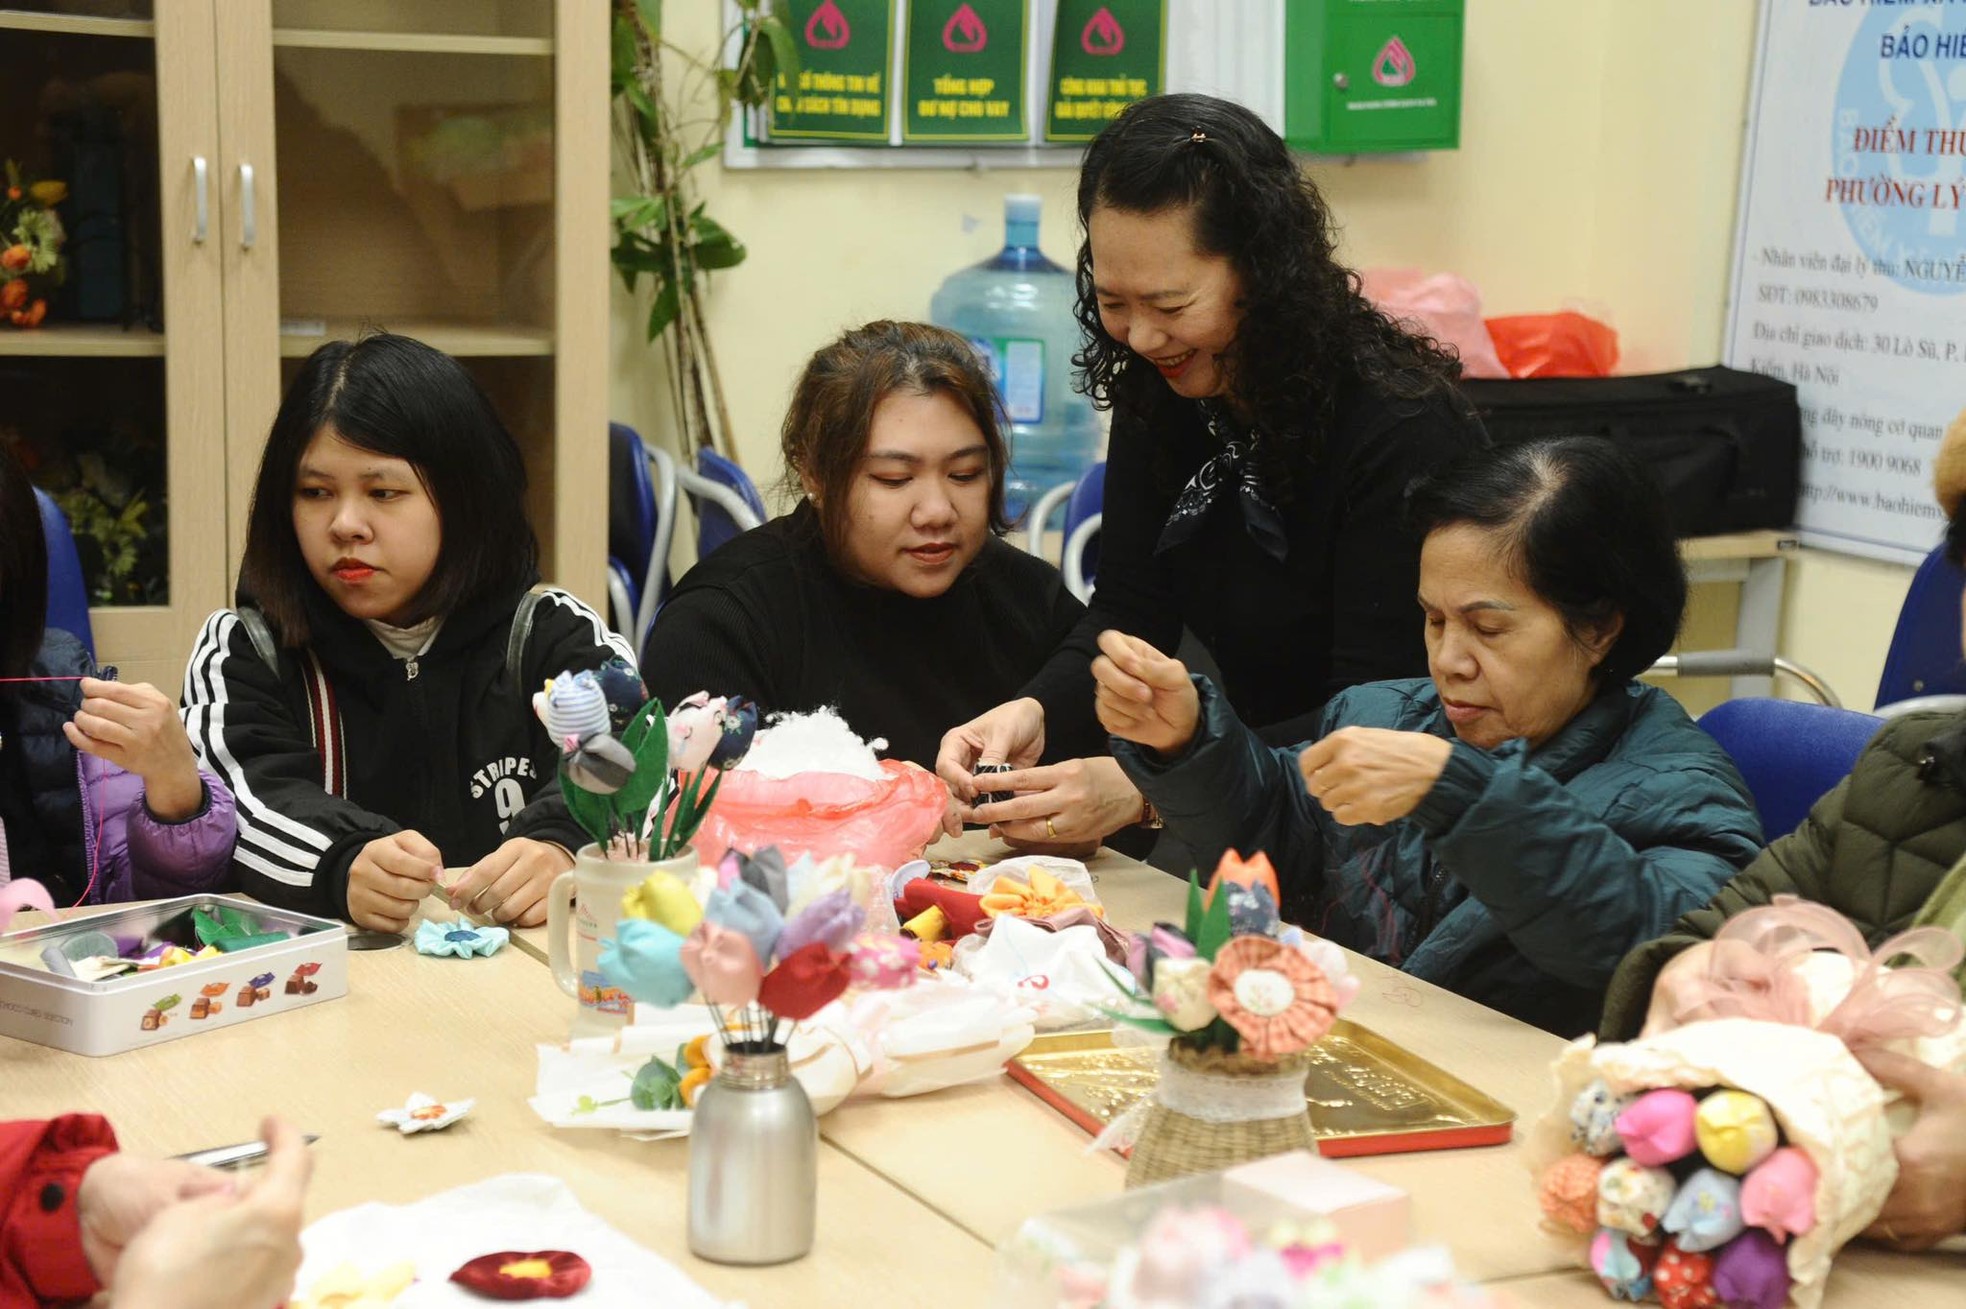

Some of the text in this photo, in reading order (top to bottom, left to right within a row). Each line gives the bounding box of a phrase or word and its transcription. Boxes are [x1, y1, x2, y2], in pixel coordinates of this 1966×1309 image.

[1881, 25, 1929, 59] BẢO
[1854, 115, 1916, 154] ĐIỂM
[1825, 173, 1925, 209] PHƯỜNG
[1872, 334, 1891, 355] 30
[1851, 449, 1883, 471] 1900
[1887, 455, 1921, 477] 9068
[494, 778, 526, 836] 9
